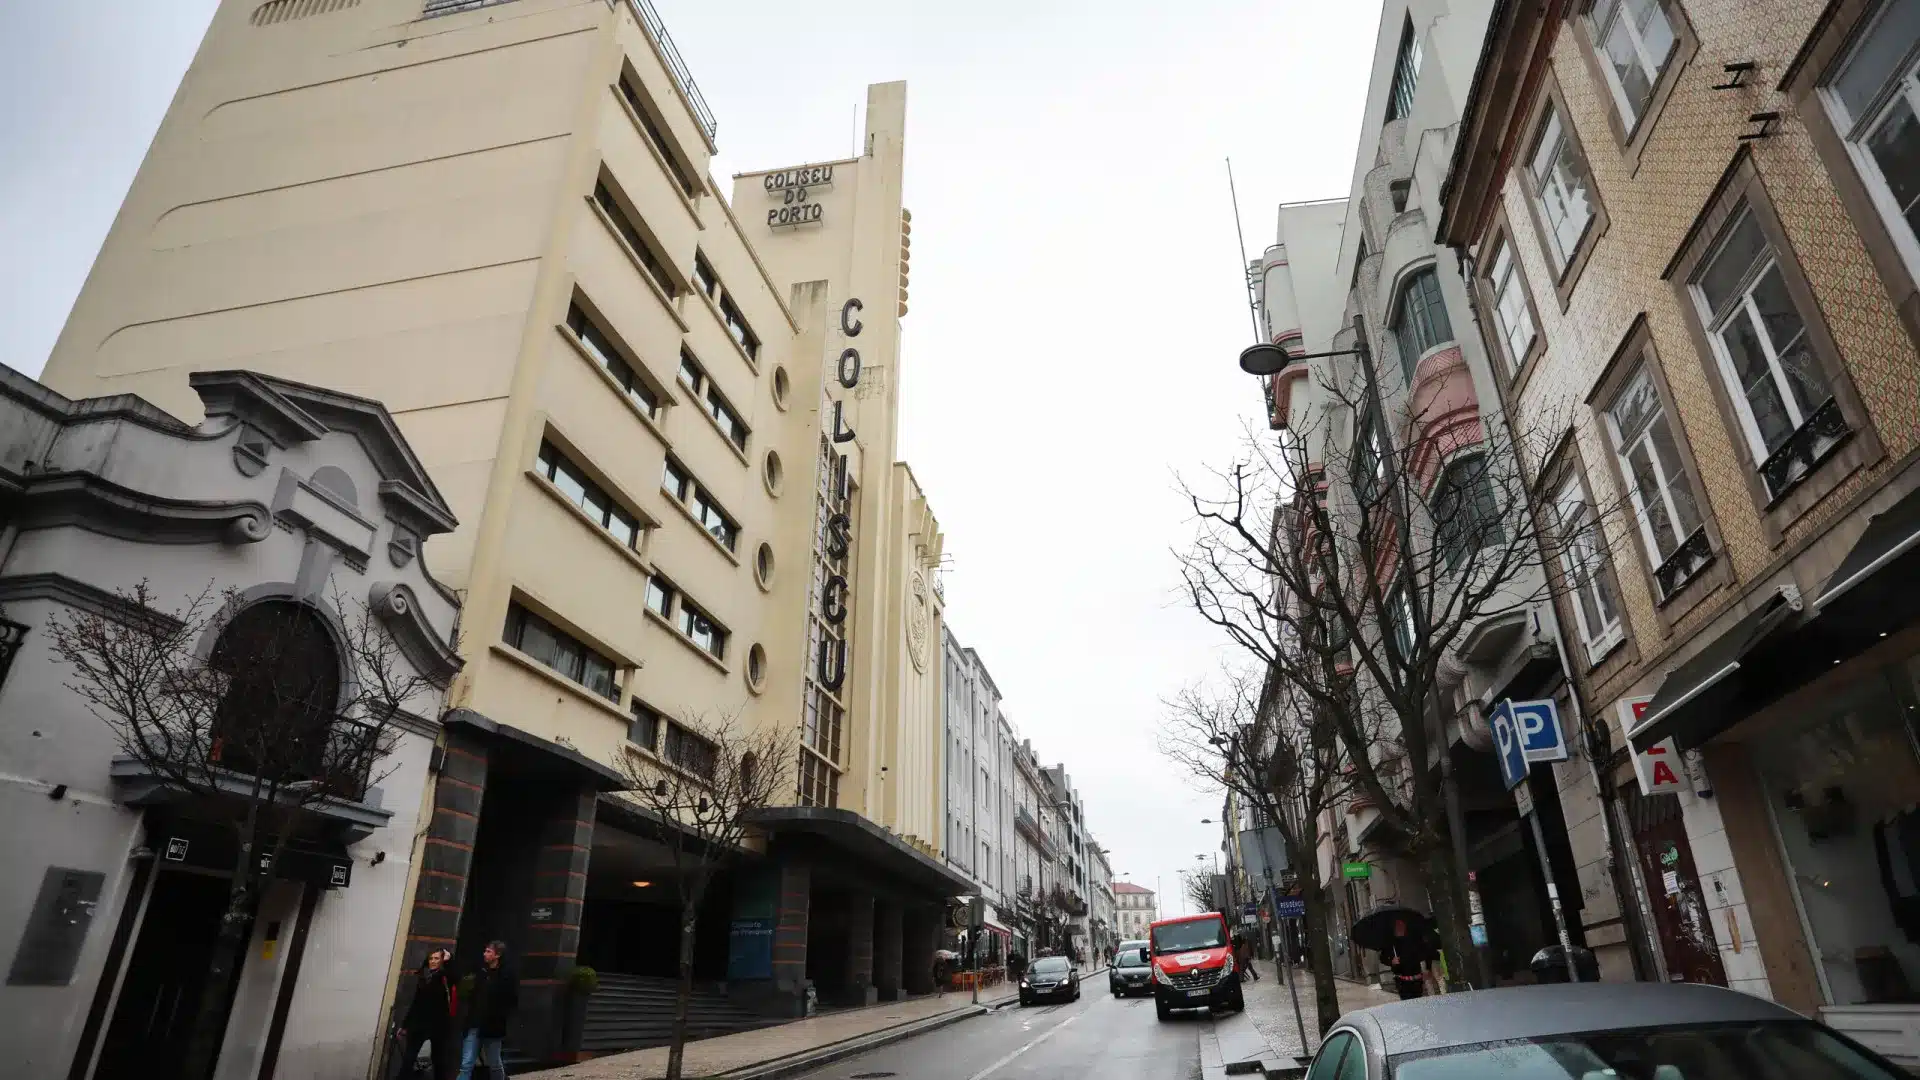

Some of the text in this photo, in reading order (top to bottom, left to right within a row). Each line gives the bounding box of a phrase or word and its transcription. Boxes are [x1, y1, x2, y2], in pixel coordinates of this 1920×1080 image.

[763, 164, 833, 190] COLISEU
[783, 188, 807, 205] DO
[767, 202, 822, 226] PORTO
[818, 297, 864, 692] COLISEU
[1516, 711, 1544, 745] P
[1494, 714, 1512, 780] P
